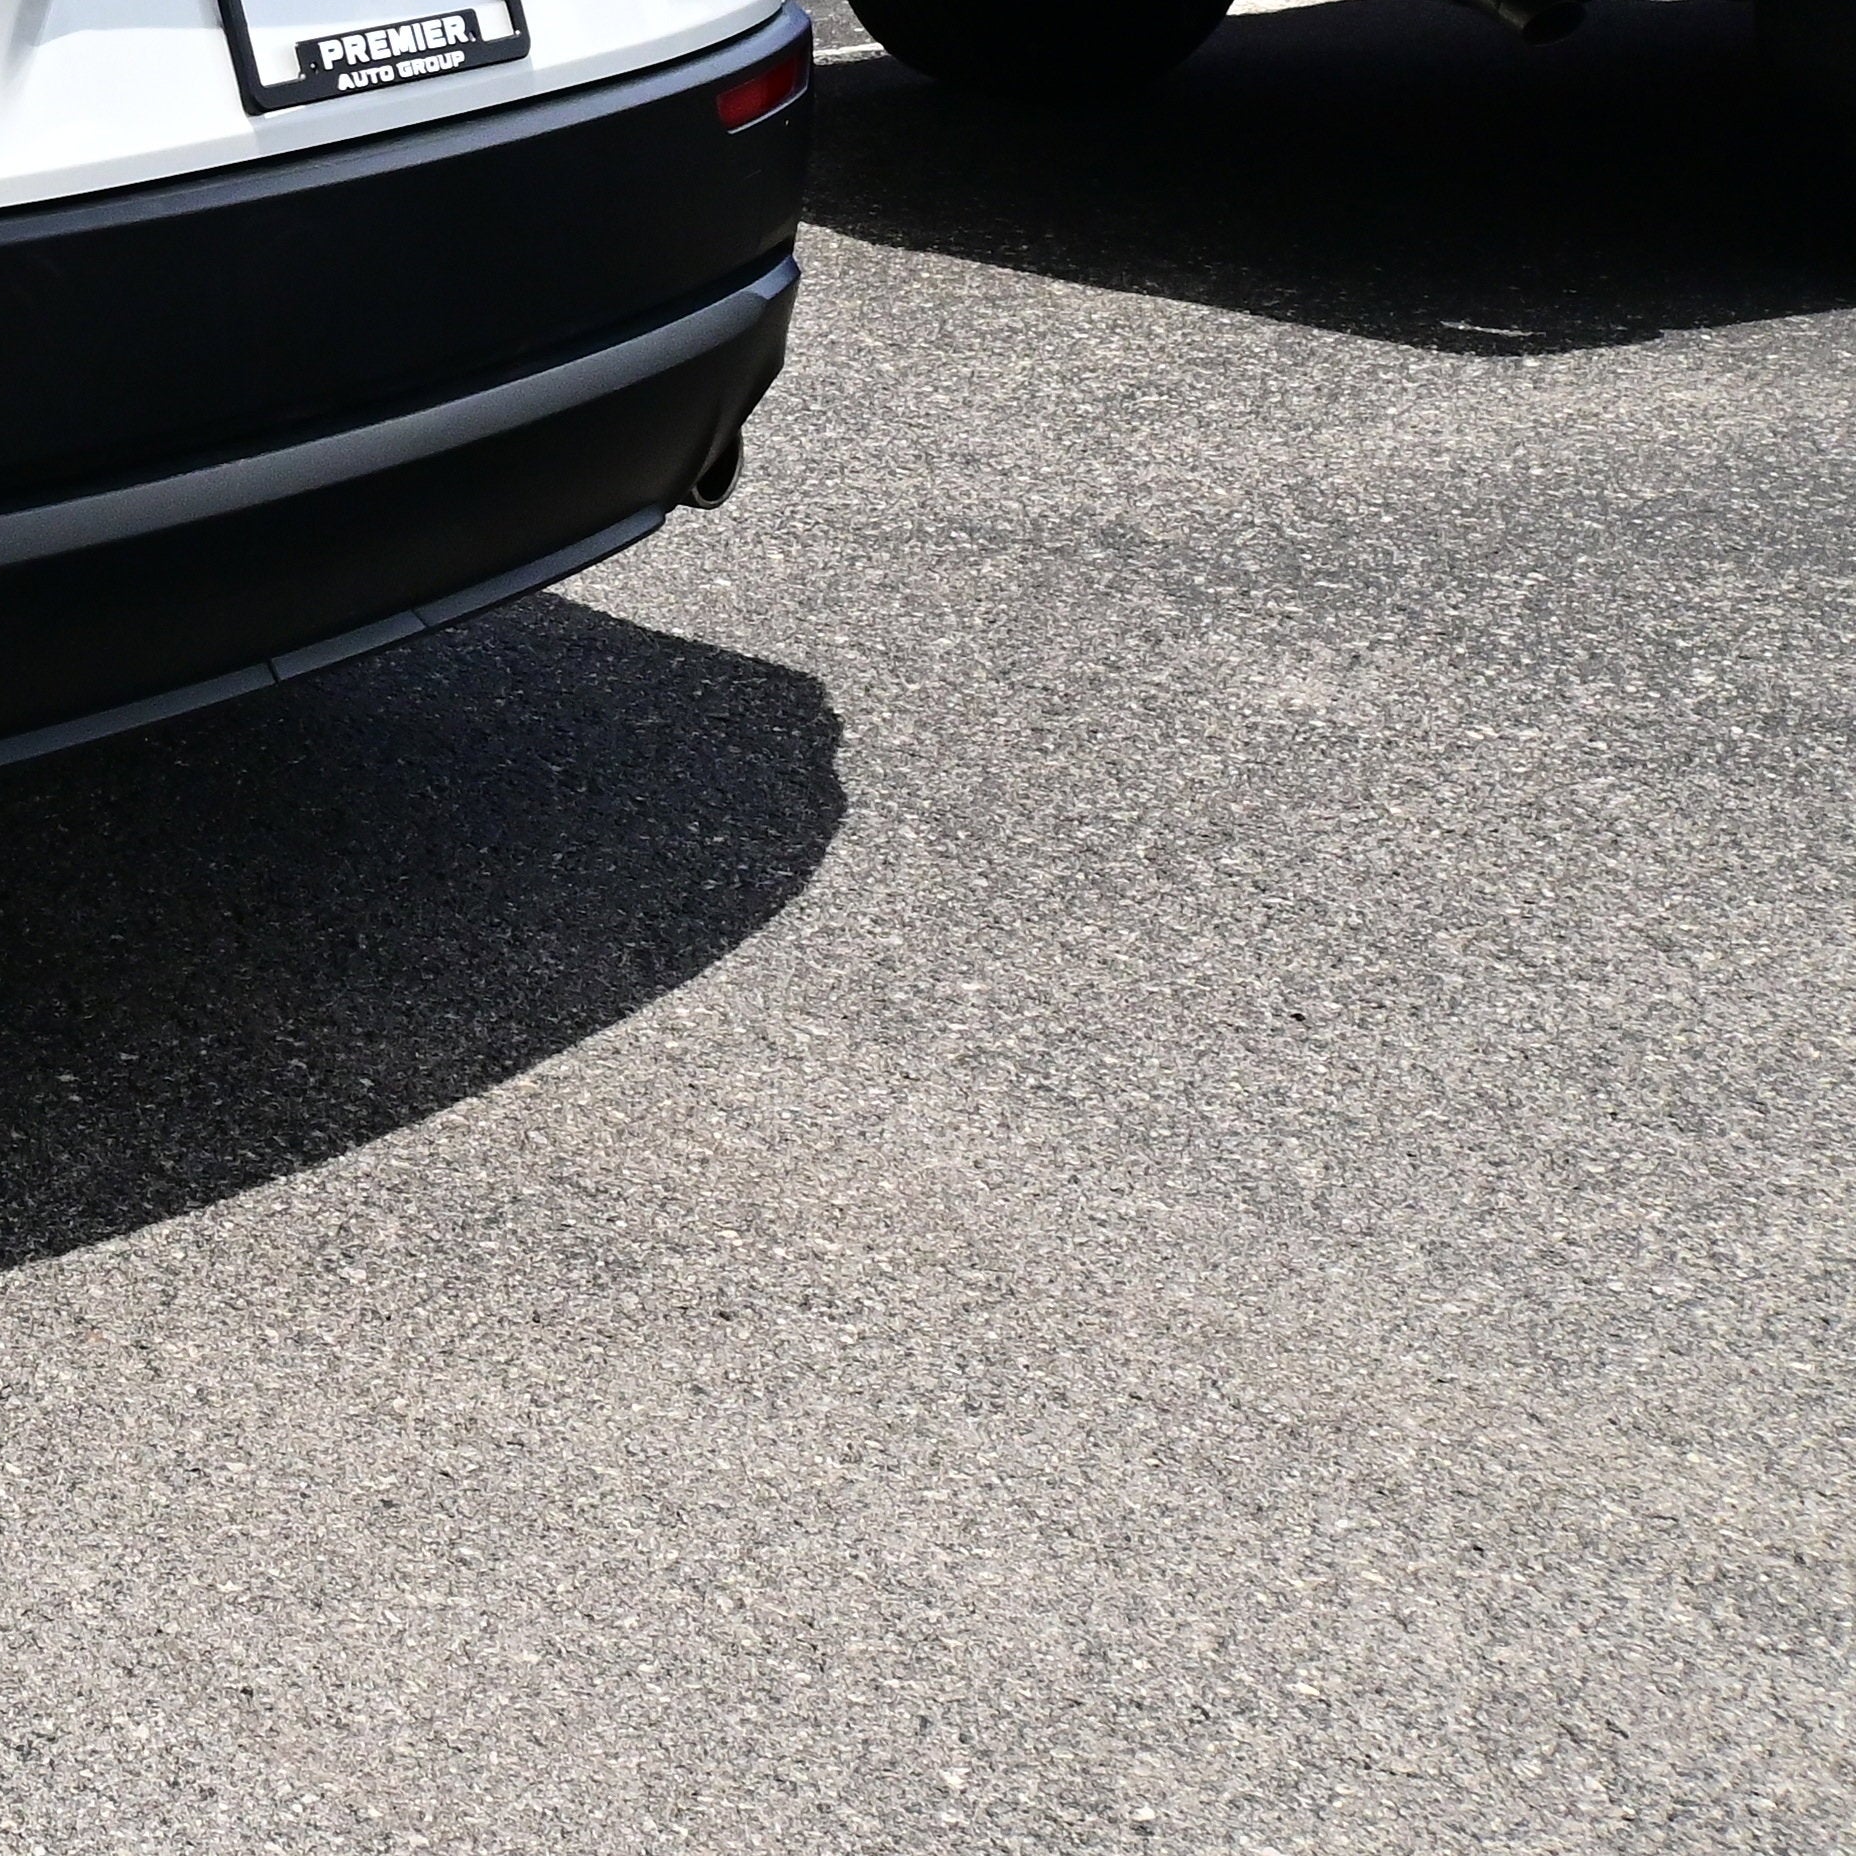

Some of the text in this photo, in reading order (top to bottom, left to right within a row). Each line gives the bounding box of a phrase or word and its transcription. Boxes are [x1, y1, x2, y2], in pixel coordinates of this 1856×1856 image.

[318, 14, 468, 71] PREMIER
[337, 50, 465, 92] AUTO GROUP
